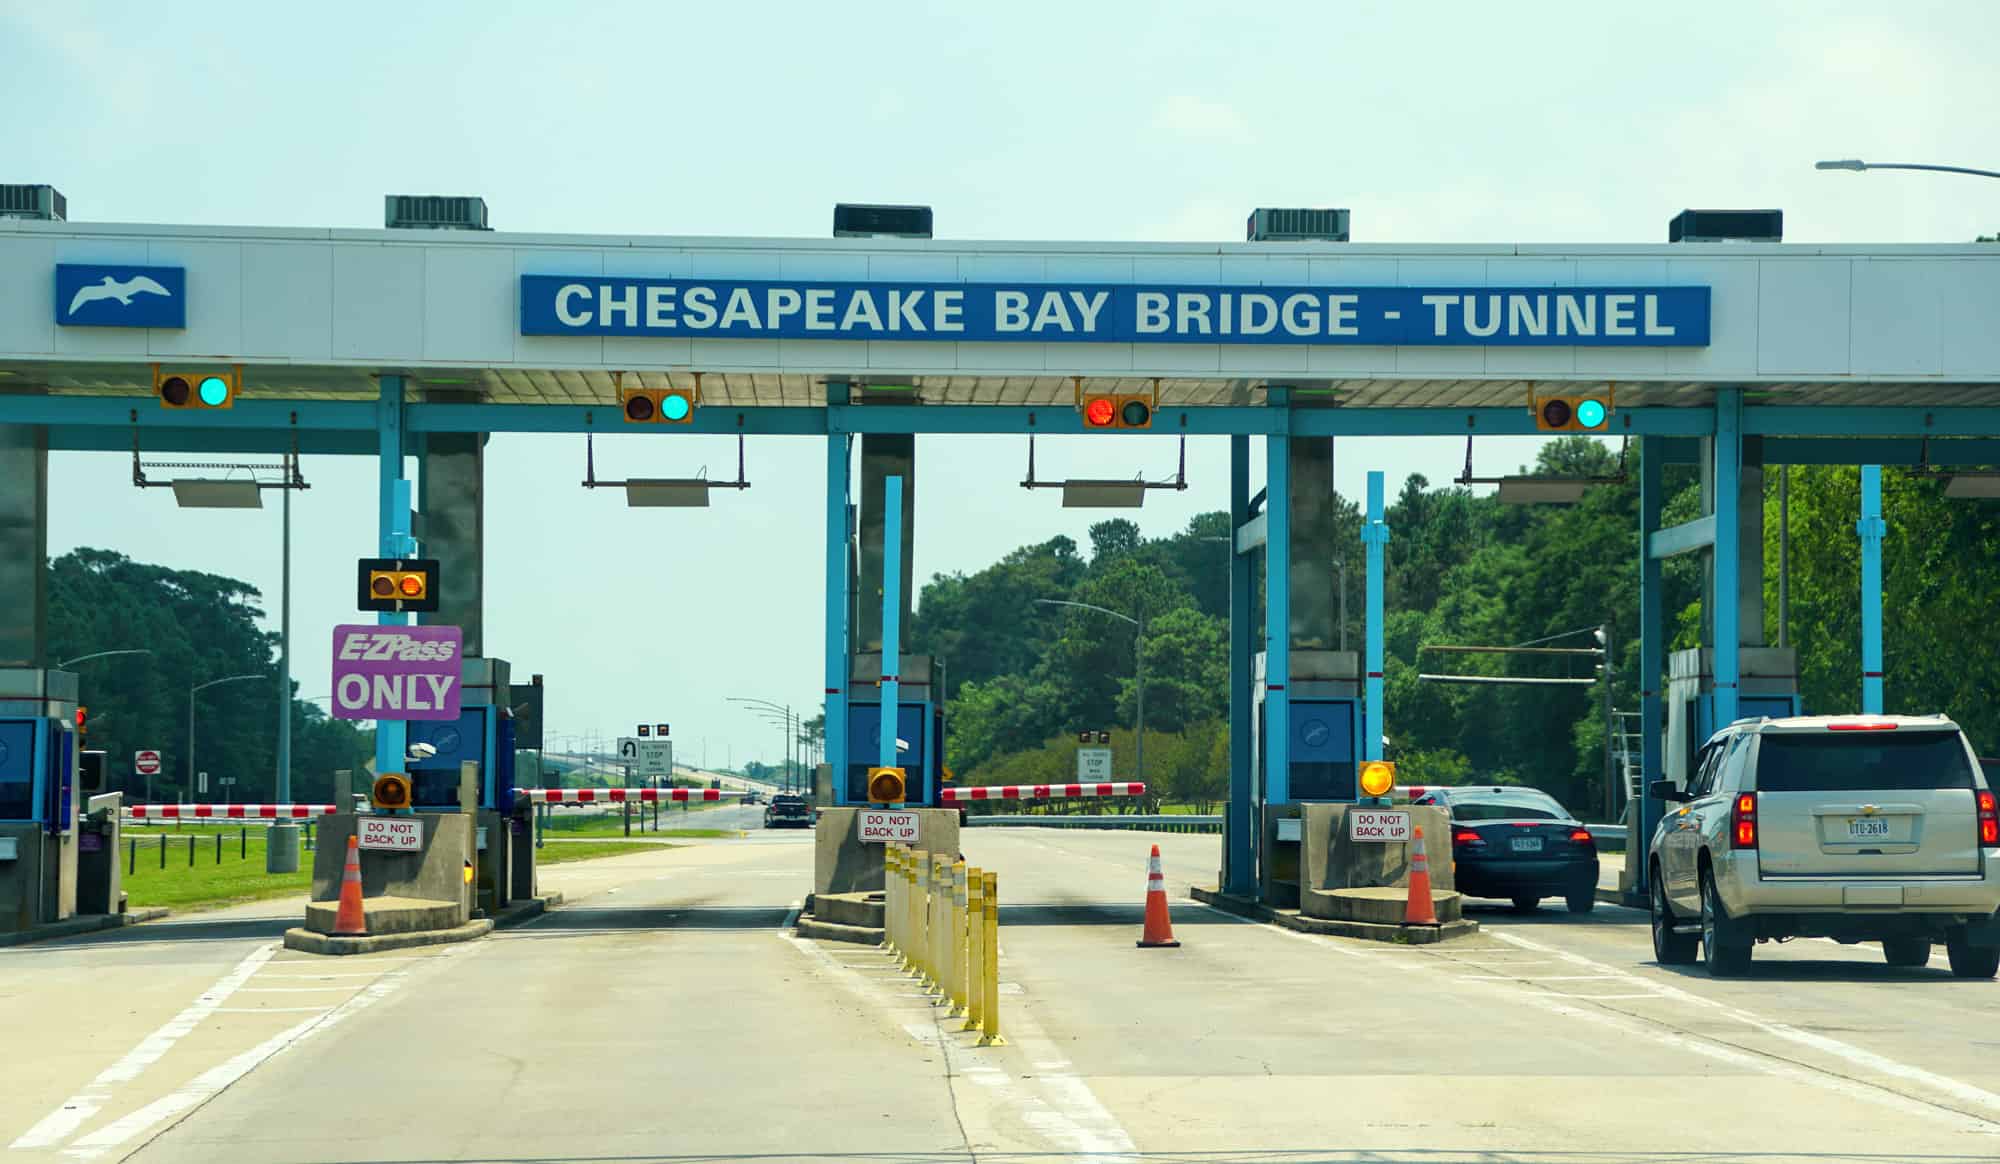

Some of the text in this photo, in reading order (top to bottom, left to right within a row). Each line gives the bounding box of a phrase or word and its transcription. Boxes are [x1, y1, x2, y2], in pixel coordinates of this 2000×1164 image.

[554, 283, 965, 332] CHESAPEAKE
[994, 290, 1109, 333] BAY
[1135, 292, 1359, 336] BRIDGE
[1422, 294, 1676, 337] TUNNEL
[336, 672, 456, 711] ONLY
[867, 815, 911, 826] DO NOT
[1358, 815, 1401, 825] DO NOT
[367, 822, 413, 834] DO NOT
[864, 826, 914, 838] BACK UP
[1356, 826, 1405, 838] BACK UP
[364, 833, 417, 846] BACK UP
